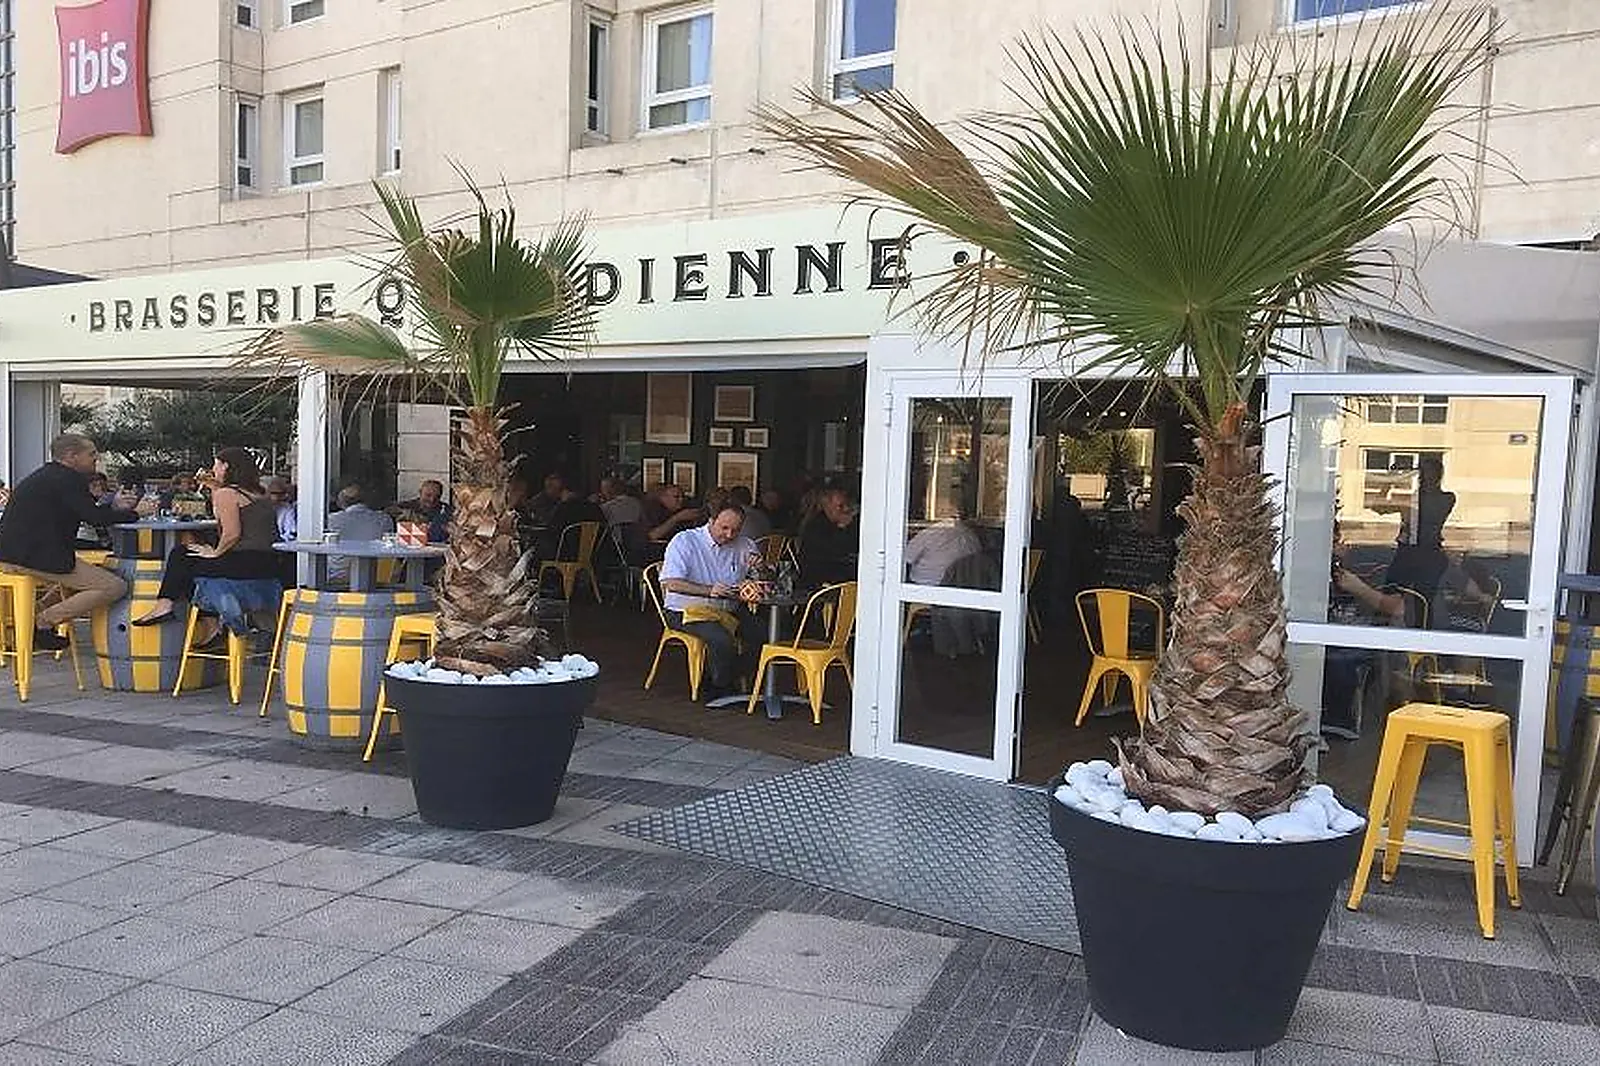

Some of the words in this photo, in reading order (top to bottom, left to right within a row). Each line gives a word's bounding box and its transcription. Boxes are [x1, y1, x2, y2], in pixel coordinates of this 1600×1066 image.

[68, 31, 128, 97] ibis
[89, 283, 335, 331] BRASSERIE
[376, 238, 911, 326] QDIENNE
